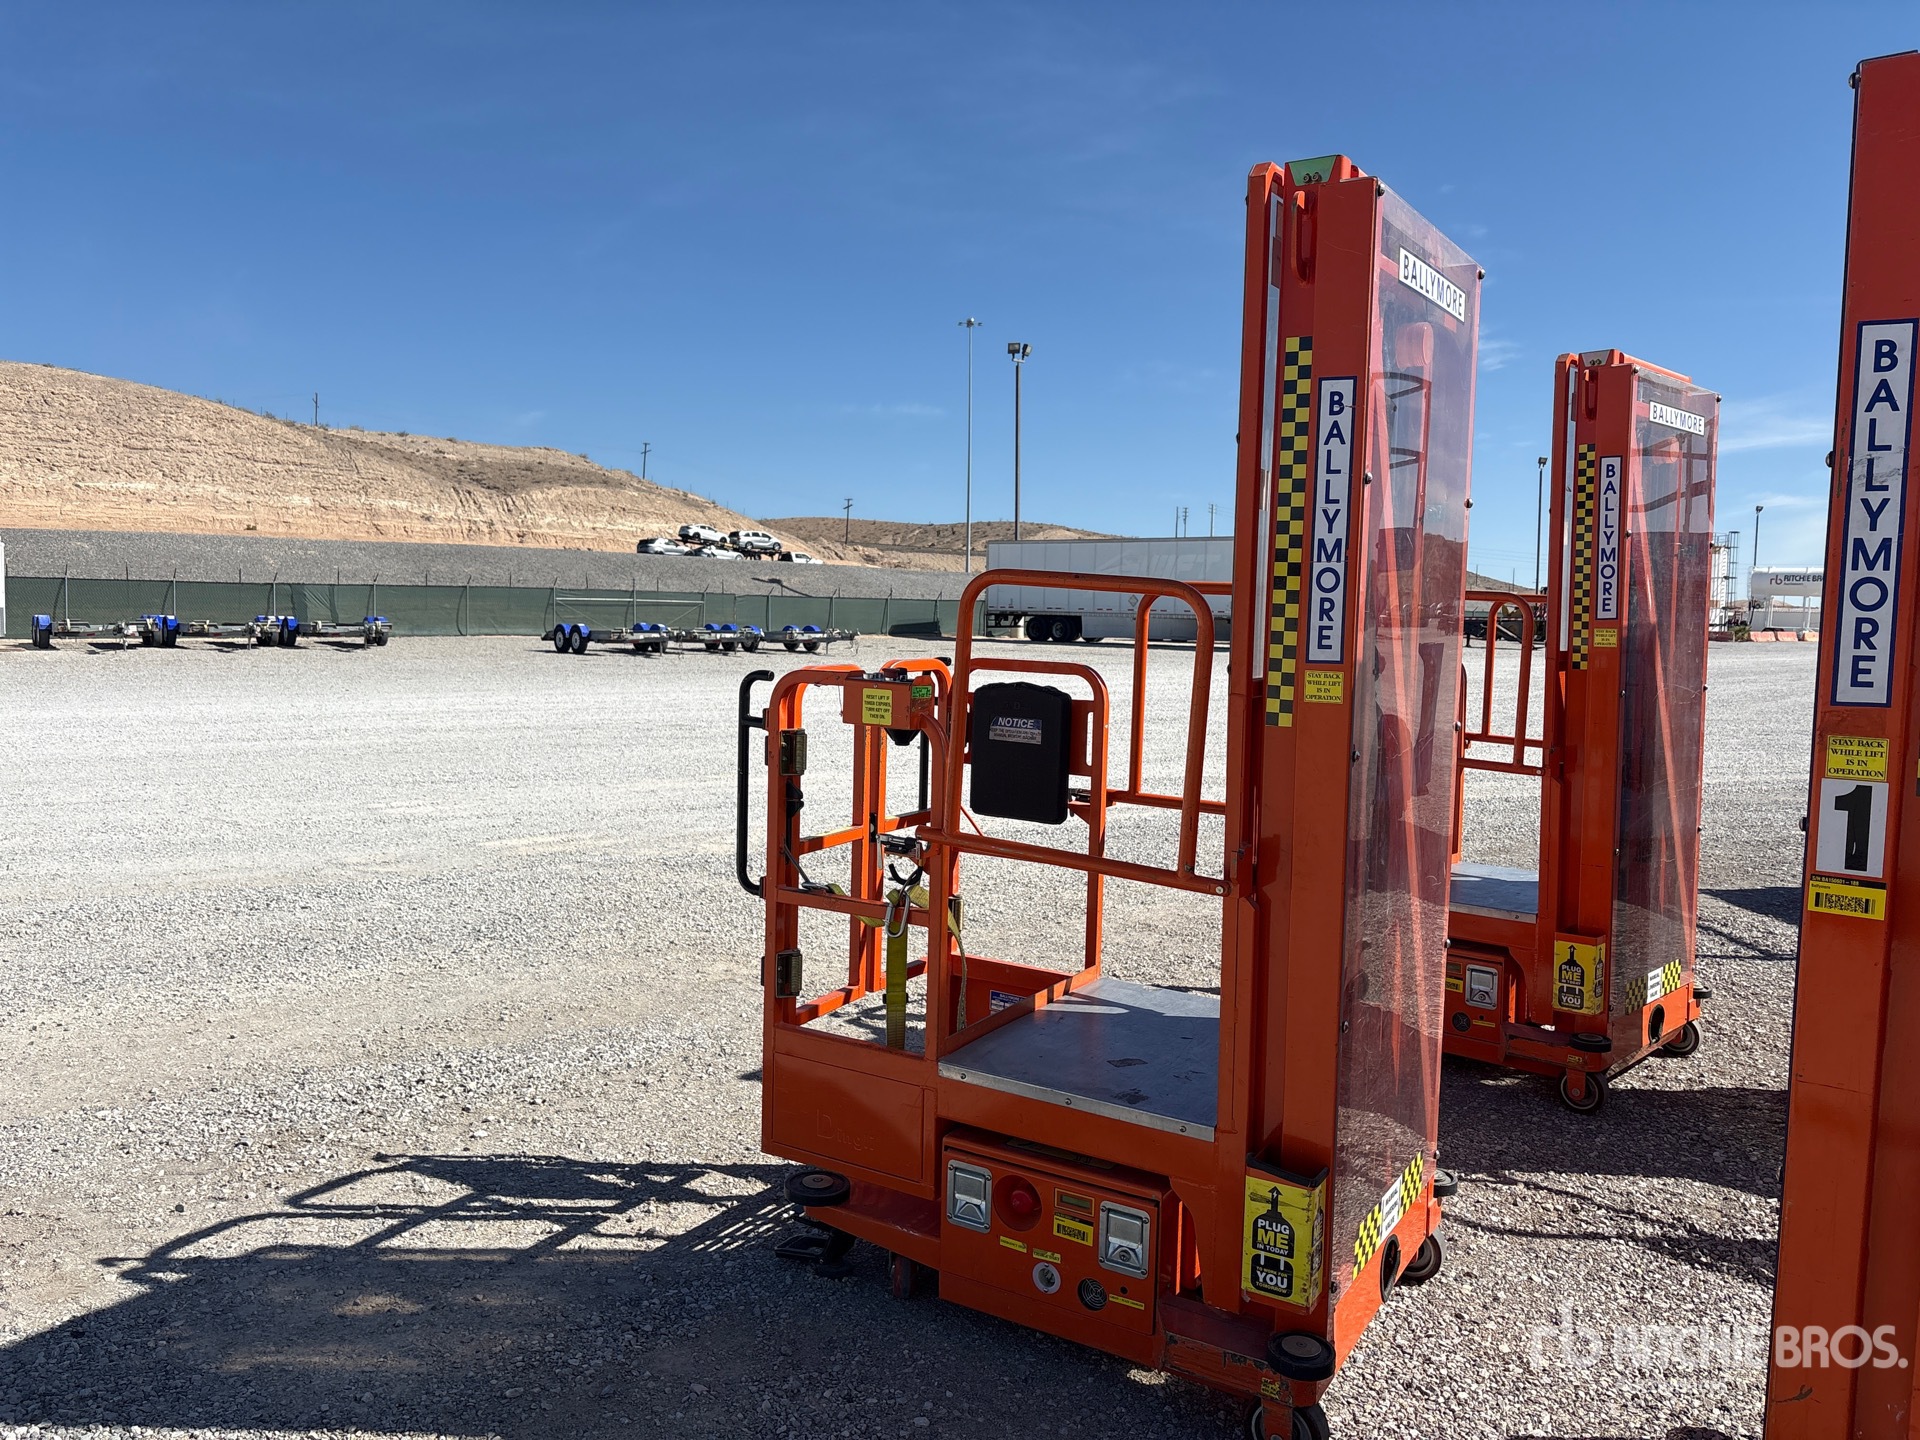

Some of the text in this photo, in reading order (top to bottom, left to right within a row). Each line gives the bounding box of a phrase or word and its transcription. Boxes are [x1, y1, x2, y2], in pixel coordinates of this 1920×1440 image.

[1403, 254, 1462, 316] BALLYMORE
[1652, 404, 1702, 433] BALLYMORE
[1849, 338, 1900, 688] BALLYMORE
[1315, 391, 1346, 650] BALLYMORE
[1600, 463, 1617, 612] BALLYMORE
[998, 717, 1034, 728] NOTICE
[1857, 740, 1885, 748] BACK
[1830, 748, 1885, 758] WHILE LIFT
[1828, 767, 1884, 778] OPERATION
[1834, 784, 1873, 871] 1
[1561, 964, 1582, 973] PLUG
[1561, 970, 1582, 982] ME
[1561, 995, 1581, 1005] YOU
[1257, 1218, 1290, 1235] PLUG
[1257, 1228, 1289, 1250] ME
[1266, 1245, 1289, 1256] TODAY
[1256, 1270, 1288, 1289] YOU
[1256, 1281, 1287, 1293] TOMORROW
